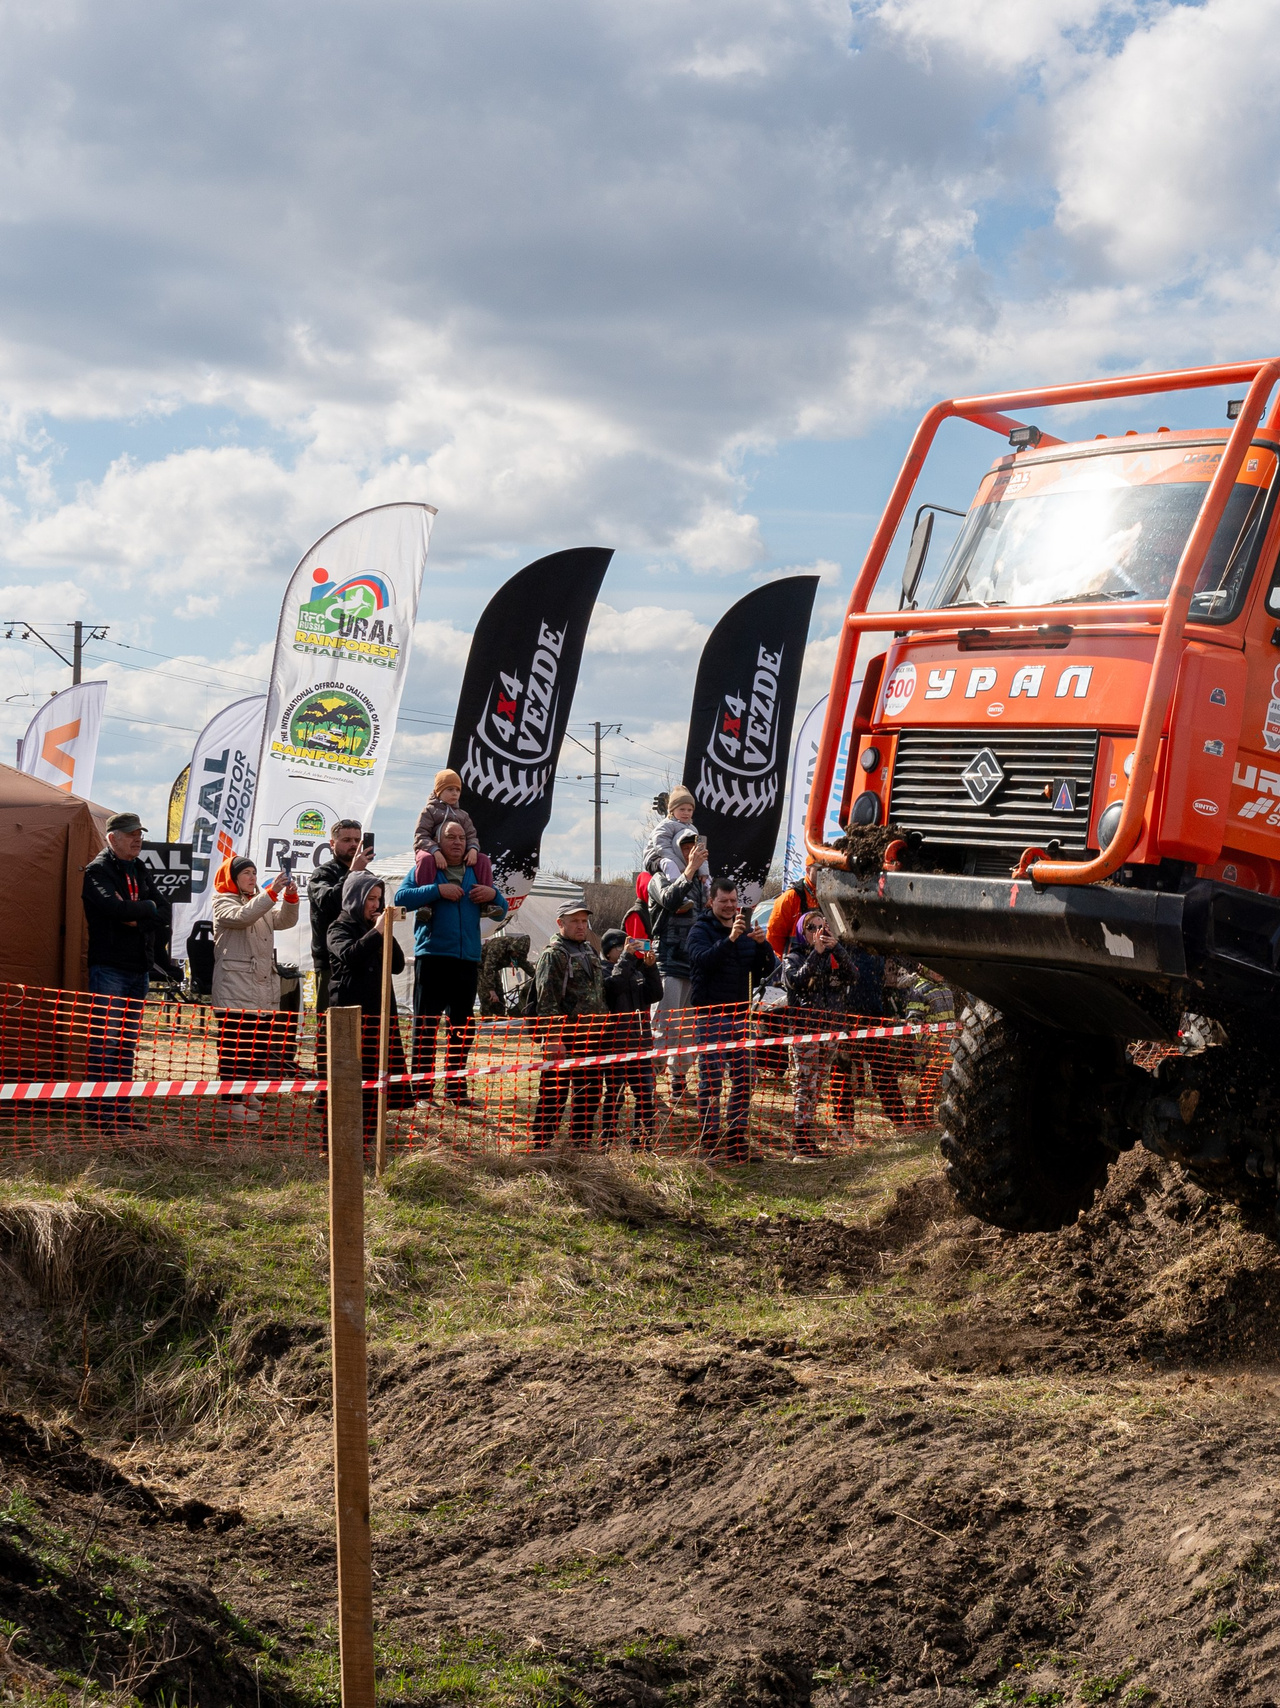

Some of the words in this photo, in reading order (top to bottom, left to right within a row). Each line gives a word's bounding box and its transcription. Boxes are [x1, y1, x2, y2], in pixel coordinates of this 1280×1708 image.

[299, 620, 326, 632] RUSSIA
[300, 611, 326, 624] RFC
[338, 613, 400, 648] URAL
[293, 643, 398, 669] CHALLENGE
[295, 630, 400, 660] RAINFOREST
[314, 681, 345, 691] OFFROAD
[517, 617, 569, 752] VEZDE
[885, 679, 915, 698] 500
[924, 665, 1094, 699] УРАЛ
[281, 687, 314, 730] INTERNATIONAL
[346, 685, 376, 713] CHALLENGE
[743, 642, 785, 765] VEZDE
[371, 714, 379, 723] OF
[281, 731, 289, 742] THE
[366, 724, 380, 757] MALAYSIA
[270, 752, 375, 776] CHALLENGE
[271, 741, 378, 769] RAINFOREST
[222, 749, 247, 830] MOTOR
[233, 762, 256, 838] SPORT
[192, 748, 230, 894] URAL
[1193, 802, 1217, 813] SINTEC
